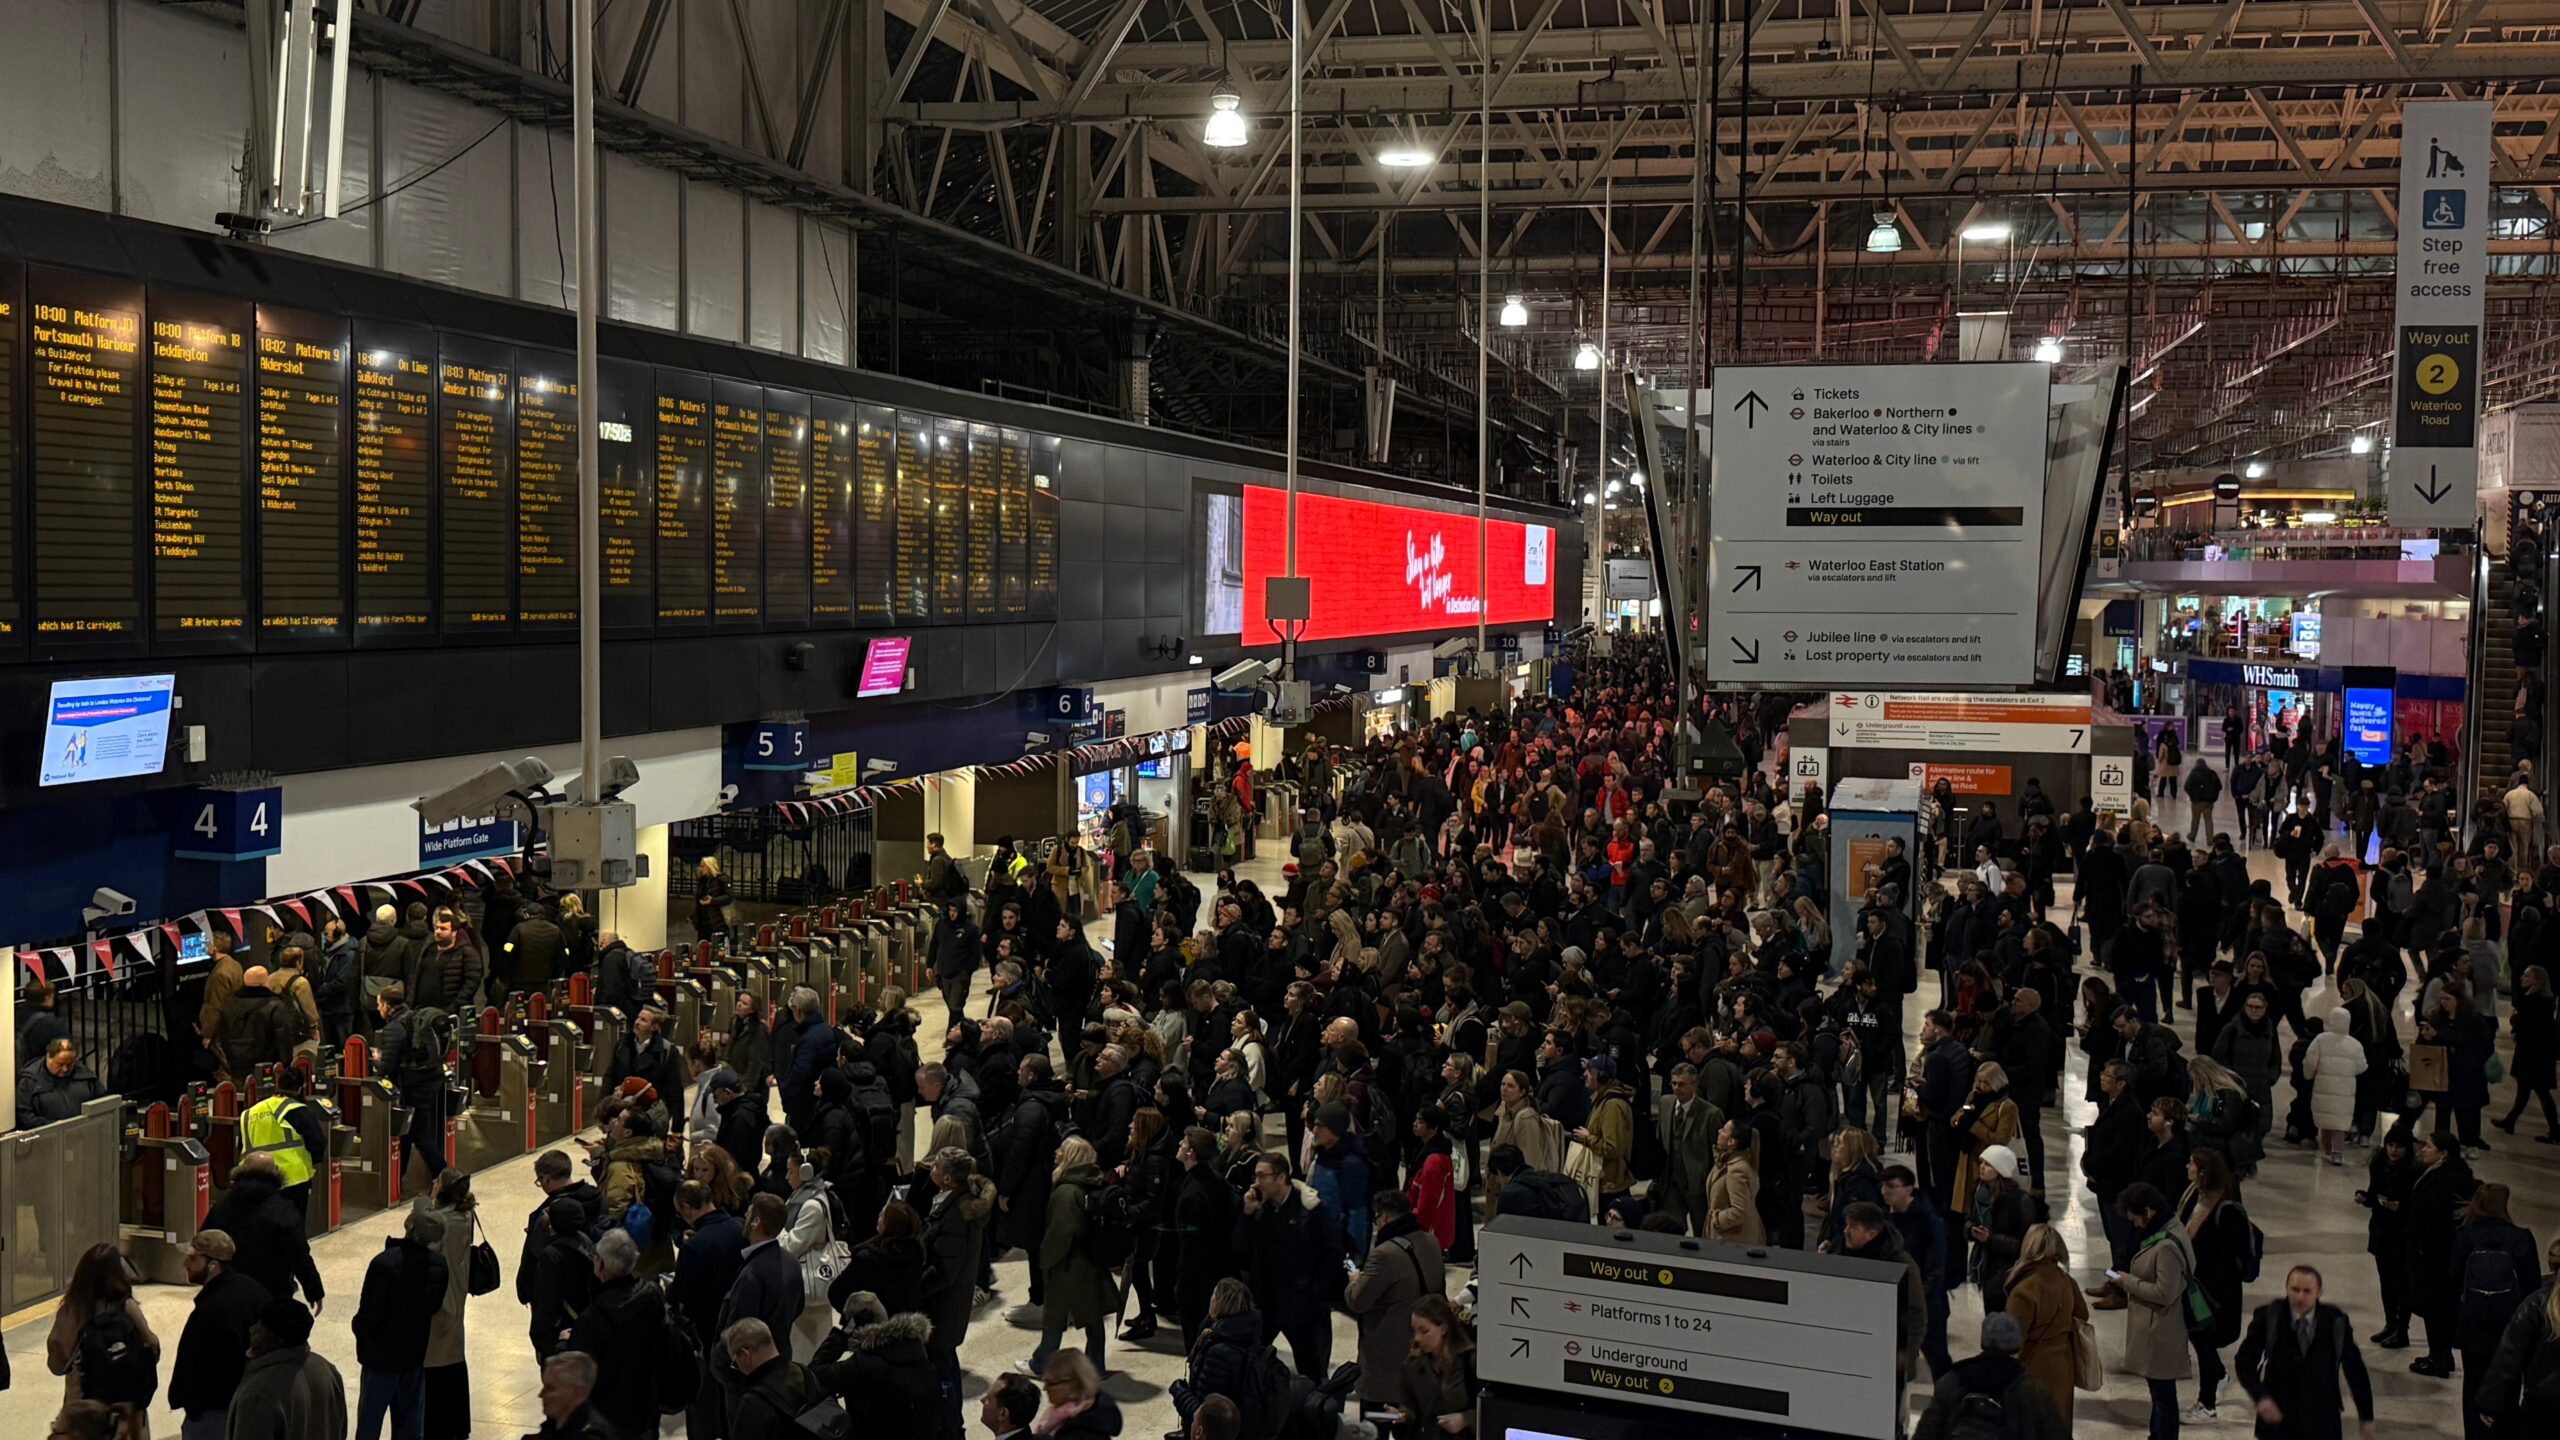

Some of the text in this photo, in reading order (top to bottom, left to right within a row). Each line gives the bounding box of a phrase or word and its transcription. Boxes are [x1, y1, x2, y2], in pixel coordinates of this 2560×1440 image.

[2423, 238, 2463, 254] Step
[2424, 260, 2460, 275] free
[2411, 283, 2471, 297] access
[35, 305, 66, 323] 18:00
[74, 310, 118, 331] Platform
[34, 325, 137, 353] Portsmouth Harbour
[154, 322, 180, 338] 18:00
[188, 326, 226, 346] Platform
[2408, 331, 2469, 349] Way out
[48, 348, 91, 362] Guildford
[154, 342, 208, 362] Teddington
[261, 338, 285, 354] 18:02
[296, 343, 330, 360] Platform
[49, 362, 120, 380] For Fratton please
[261, 357, 304, 375] Aldershot
[398, 358, 428, 374] On time
[2429, 364, 2445, 384] 2
[49, 376, 120, 393] travel in the front
[1814, 387, 1859, 400] Tickets
[1813, 407, 1943, 419] Bakerloo Northern
[2411, 400, 2462, 412] Waterloo
[2421, 414, 2449, 426] Road
[1813, 423, 1972, 437] and Waterloo & City lines
[1813, 438, 1849, 446] via stairs
[1812, 454, 1870, 466] Waterloo
[1874, 455, 1882, 465] &
[1885, 454, 1910, 467] City
[1914, 454, 1936, 465] line
[1967, 456, 1979, 465] lift
[1811, 473, 1852, 484] Toilets
[1810, 492, 1894, 506] Left Luggage
[1810, 511, 1862, 524] Way out
[1809, 560, 1944, 571] Waterloo East Station
[1502, 638, 1515, 648] 10
[1548, 632, 1559, 641] 11
[1806, 631, 1851, 643] Jubilee
[1854, 632, 1875, 642] line
[1906, 635, 1949, 644] escalators
[1951, 635, 1967, 644] and
[1969, 635, 1981, 644] lift
[2299, 620, 2316, 660] PRET
[1367, 656, 1375, 668] 8
[1806, 650, 1832, 661] Lost
[1835, 650, 1890, 663] property
[1906, 654, 1949, 662] escalators
[1951, 654, 1967, 662] and
[1969, 654, 1982, 662] lift
[2243, 665, 2299, 688] WHSmith
[1059, 695, 1071, 713] 6
[1084, 695, 1090, 713] 6
[1942, 695, 1972, 703] replacing
[2350, 701, 2375, 710] Happy
[2350, 717, 2386, 725] delivered
[759, 732, 773, 756] 5
[794, 731, 803, 756] 5
[2069, 729, 2084, 748] 7
[1930, 766, 1965, 774] Alternative
[194, 804, 217, 838] 4
[250, 802, 268, 836] 4
[425, 833, 489, 852] Wide Platform Gate
[1590, 1260, 1670, 1281] Way out 7
[1591, 1303, 1711, 1333] Platforms 1 to 24
[1591, 1345, 1688, 1372] Underground
[1590, 1368, 1670, 1391] Way out 2
